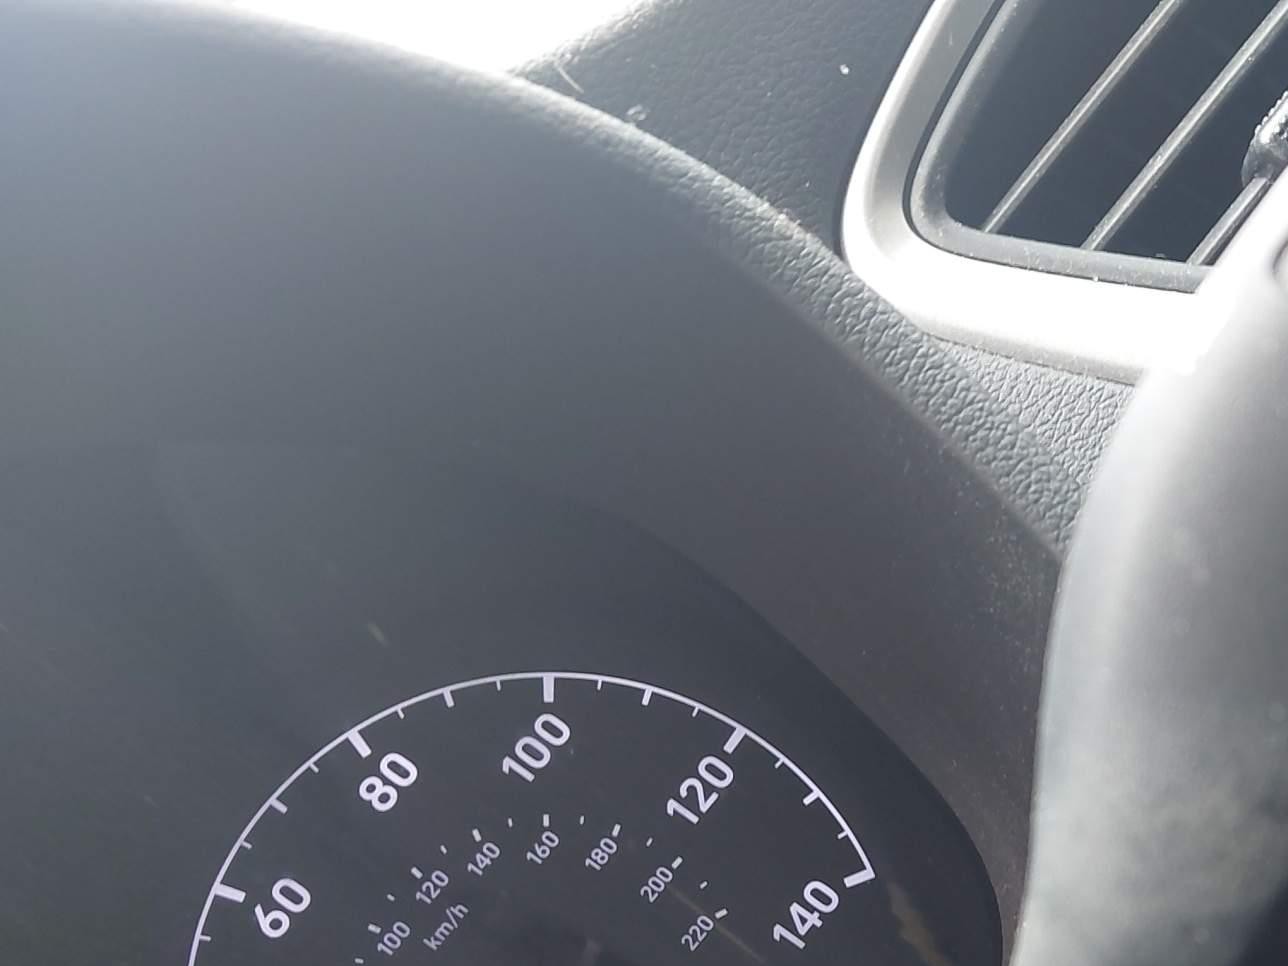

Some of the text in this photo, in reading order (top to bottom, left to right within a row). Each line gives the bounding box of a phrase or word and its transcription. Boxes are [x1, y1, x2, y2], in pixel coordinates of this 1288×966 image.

[503, 713, 571, 782] 100
[358, 752, 418, 812] 80
[666, 755, 734, 824] 120
[467, 841, 501, 877] 140
[526, 830, 560, 865] 160
[585, 836, 618, 871] 180
[415, 869, 449, 905] 120
[640, 865, 674, 903] 200
[254, 878, 311, 938] 60
[422, 902, 469, 951] km/h
[773, 880, 839, 949] 140
[377, 920, 411, 956] 100
[681, 914, 714, 952] 220
